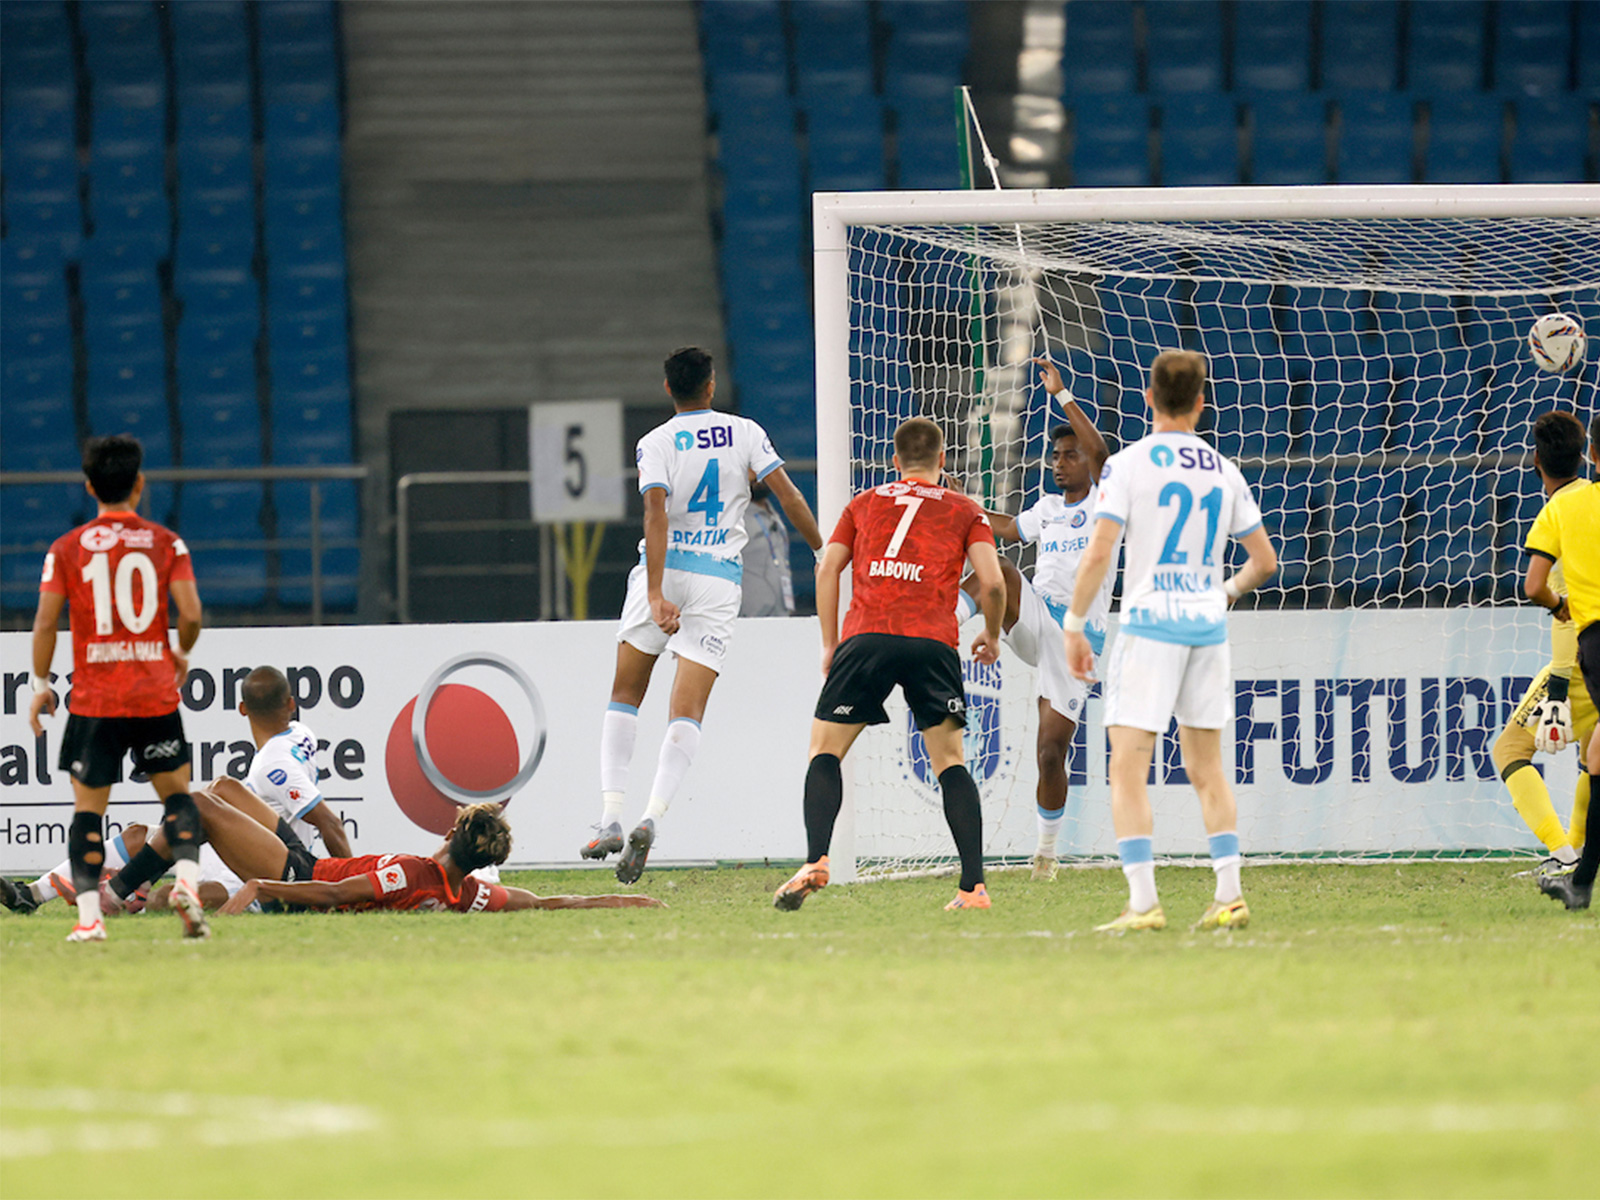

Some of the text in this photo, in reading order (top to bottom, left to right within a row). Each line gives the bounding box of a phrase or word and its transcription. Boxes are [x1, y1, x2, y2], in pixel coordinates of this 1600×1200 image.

[564, 423, 588, 499] 5
[696, 425, 734, 450] SBI
[1178, 447, 1223, 474] SBI
[687, 458, 725, 527] 4
[1157, 481, 1224, 567] 21
[883, 494, 925, 559] 7
[81, 552, 159, 636] 10
[868, 560, 925, 582] BABOVIC
